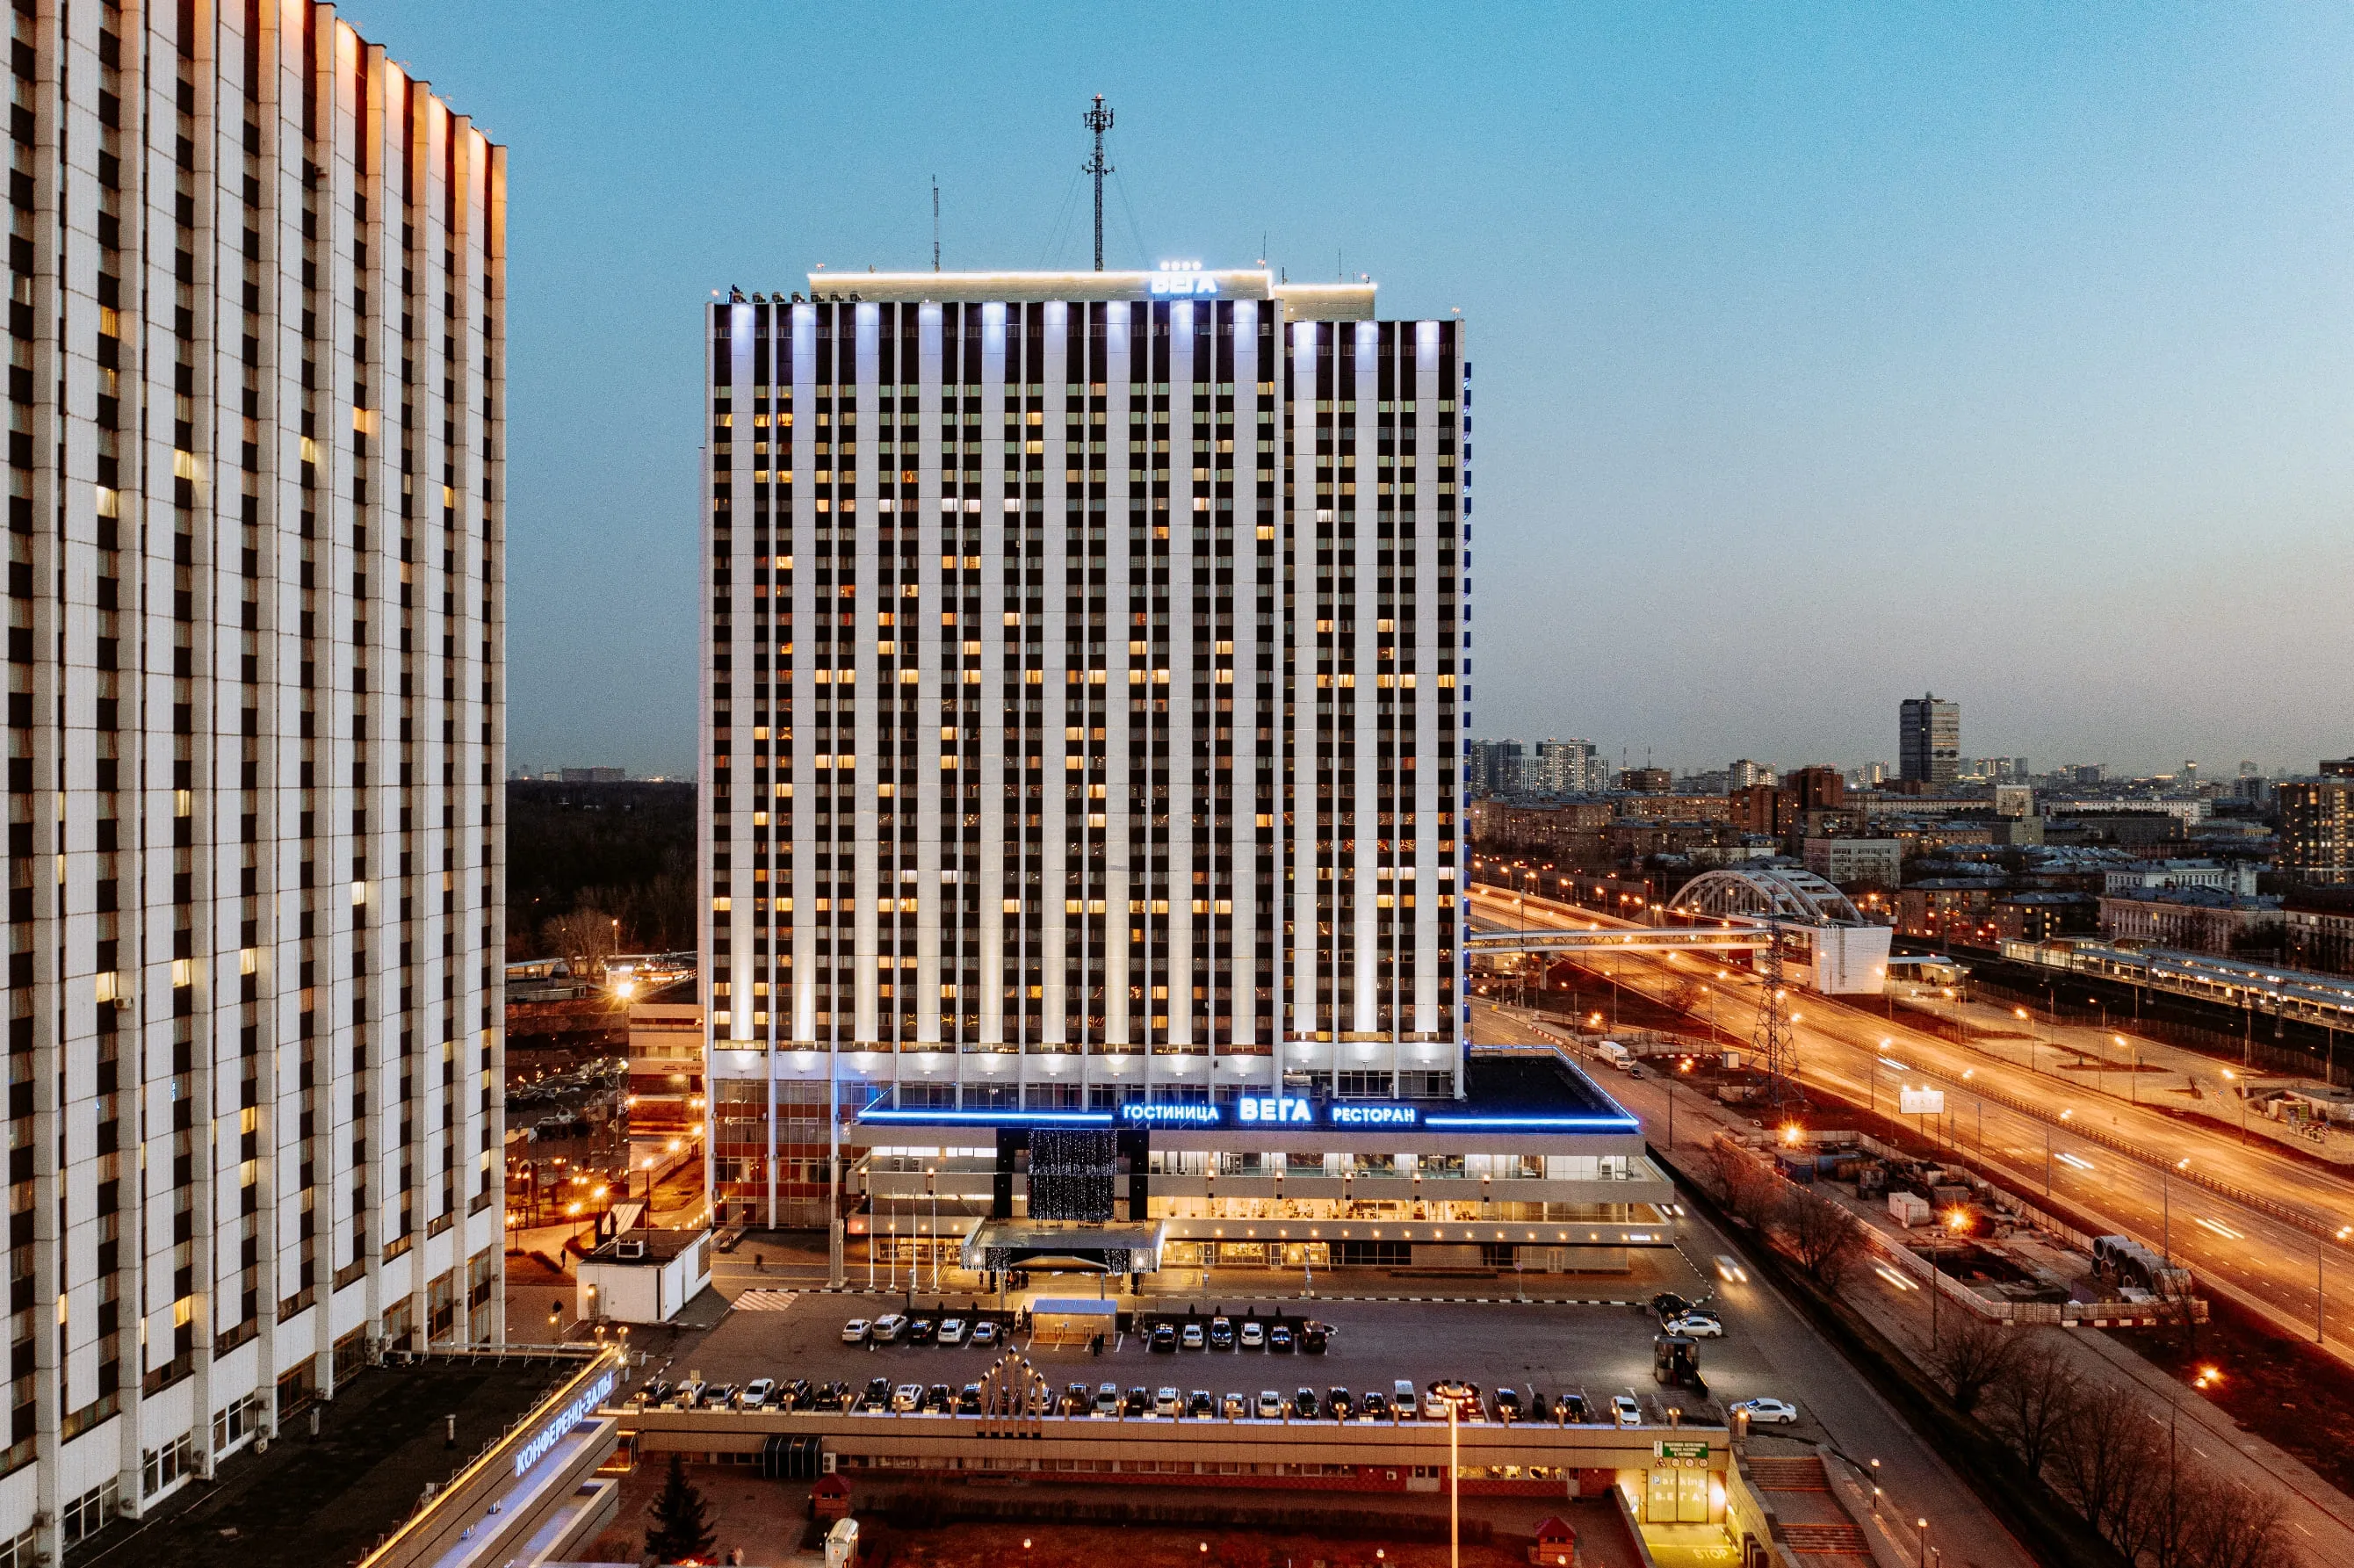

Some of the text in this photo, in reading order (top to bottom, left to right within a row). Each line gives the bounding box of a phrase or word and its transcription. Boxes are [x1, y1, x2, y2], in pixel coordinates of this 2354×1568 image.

[1123, 1098, 1415, 1123] ГОСТИНИЦА ВЕГА РЕСТОРАН
[515, 1370, 612, 1477] КОНФЕРЕНЦ-ЗАЛЫ
